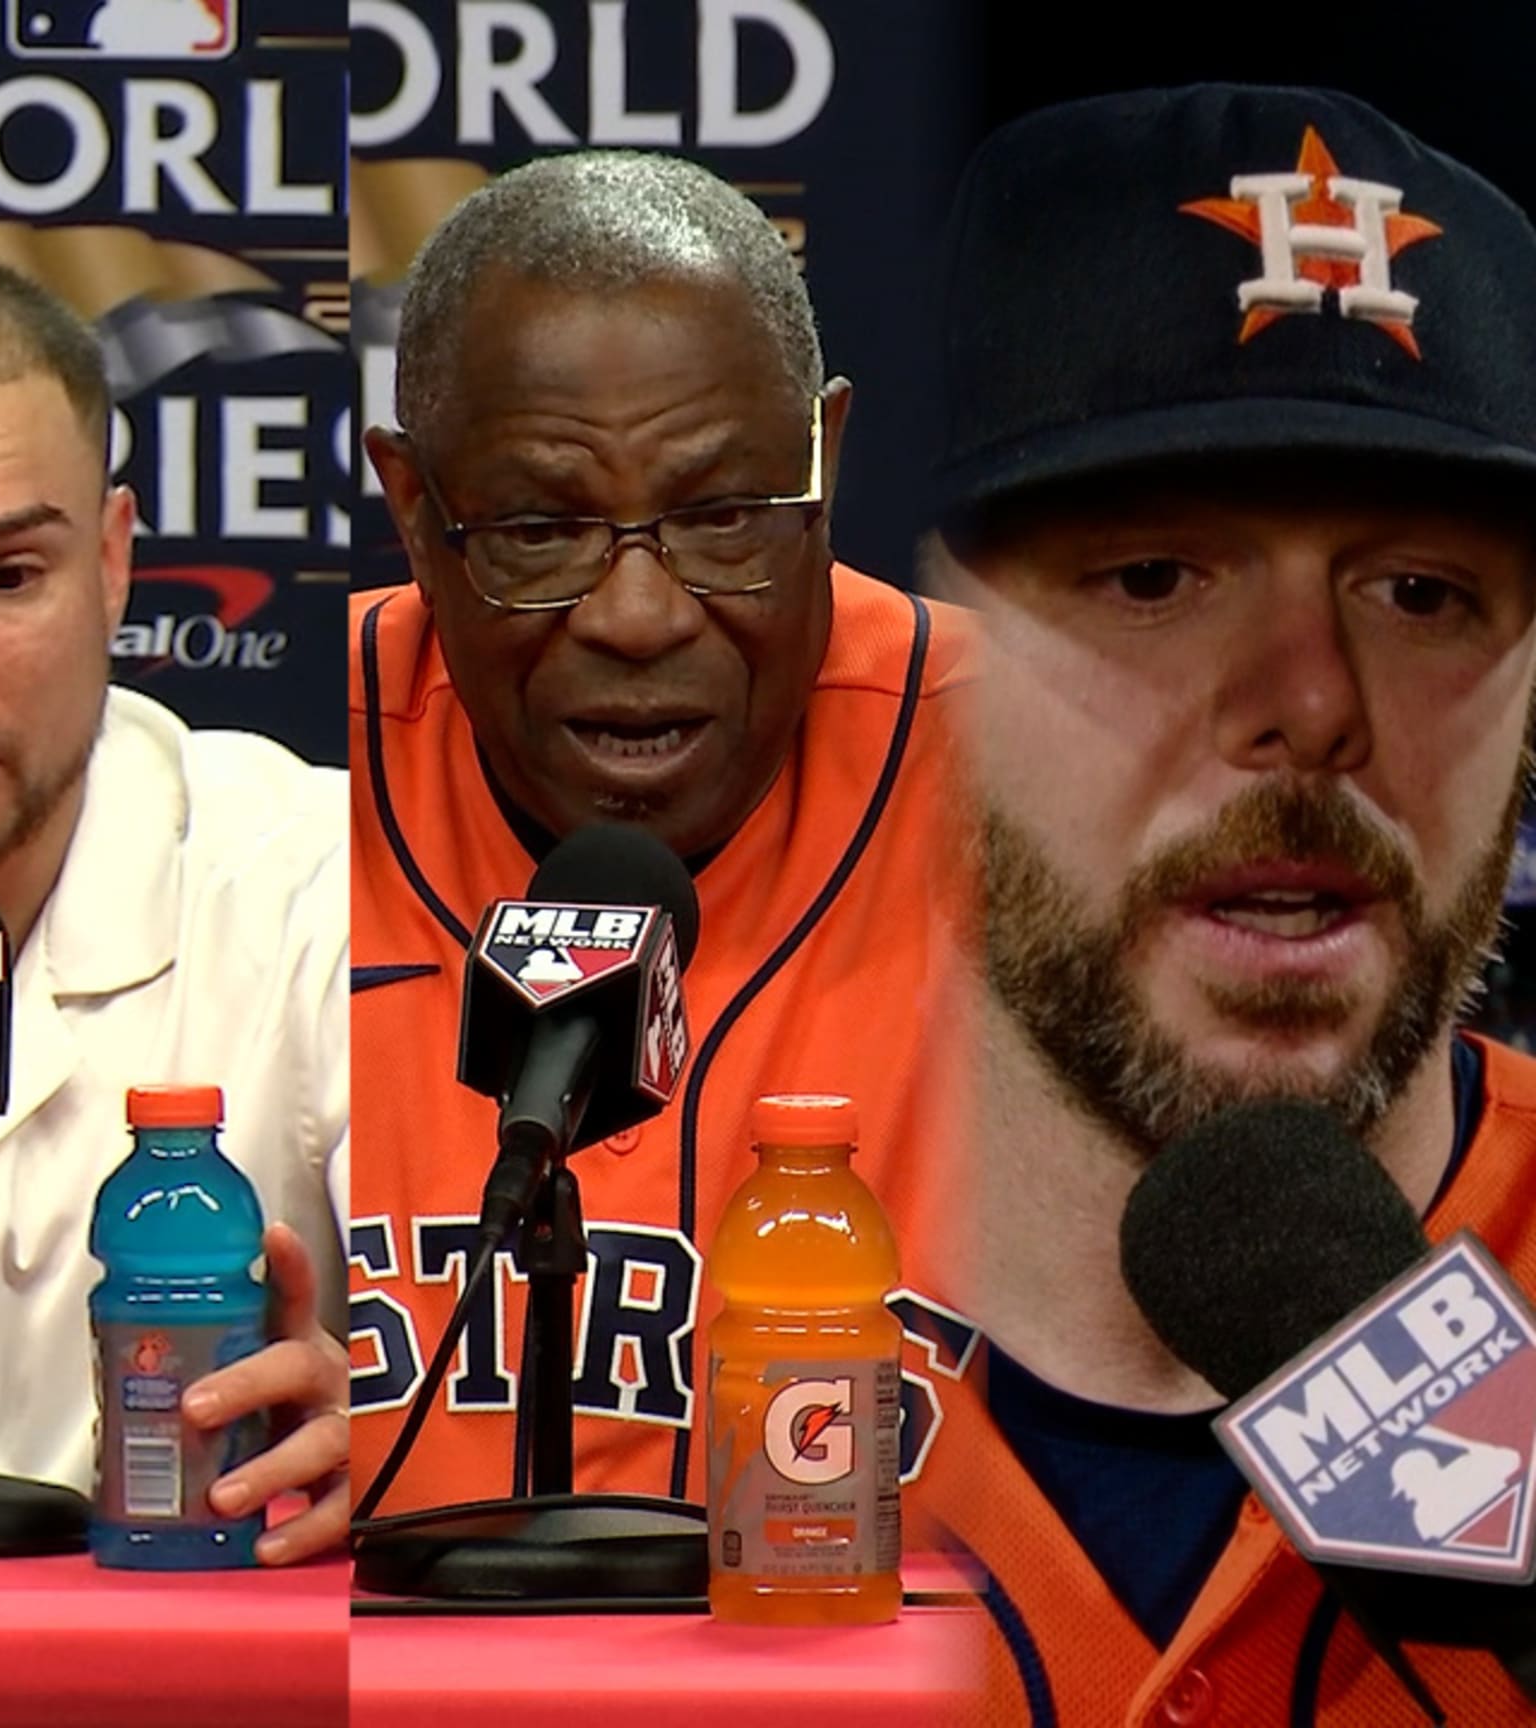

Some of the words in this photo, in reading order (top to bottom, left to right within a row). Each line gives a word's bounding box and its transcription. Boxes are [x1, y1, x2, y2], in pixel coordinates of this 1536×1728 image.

[349, 0, 834, 148] ORLD
[1231, 173, 1420, 325] H
[110, 614, 287, 669] alOne
[494, 934, 632, 949] NETWORK
[497, 907, 642, 938] MLB
[764, 1377, 855, 1485] G
[1255, 1271, 1499, 1482] MLB
[1298, 1328, 1524, 1506] NETWORK
